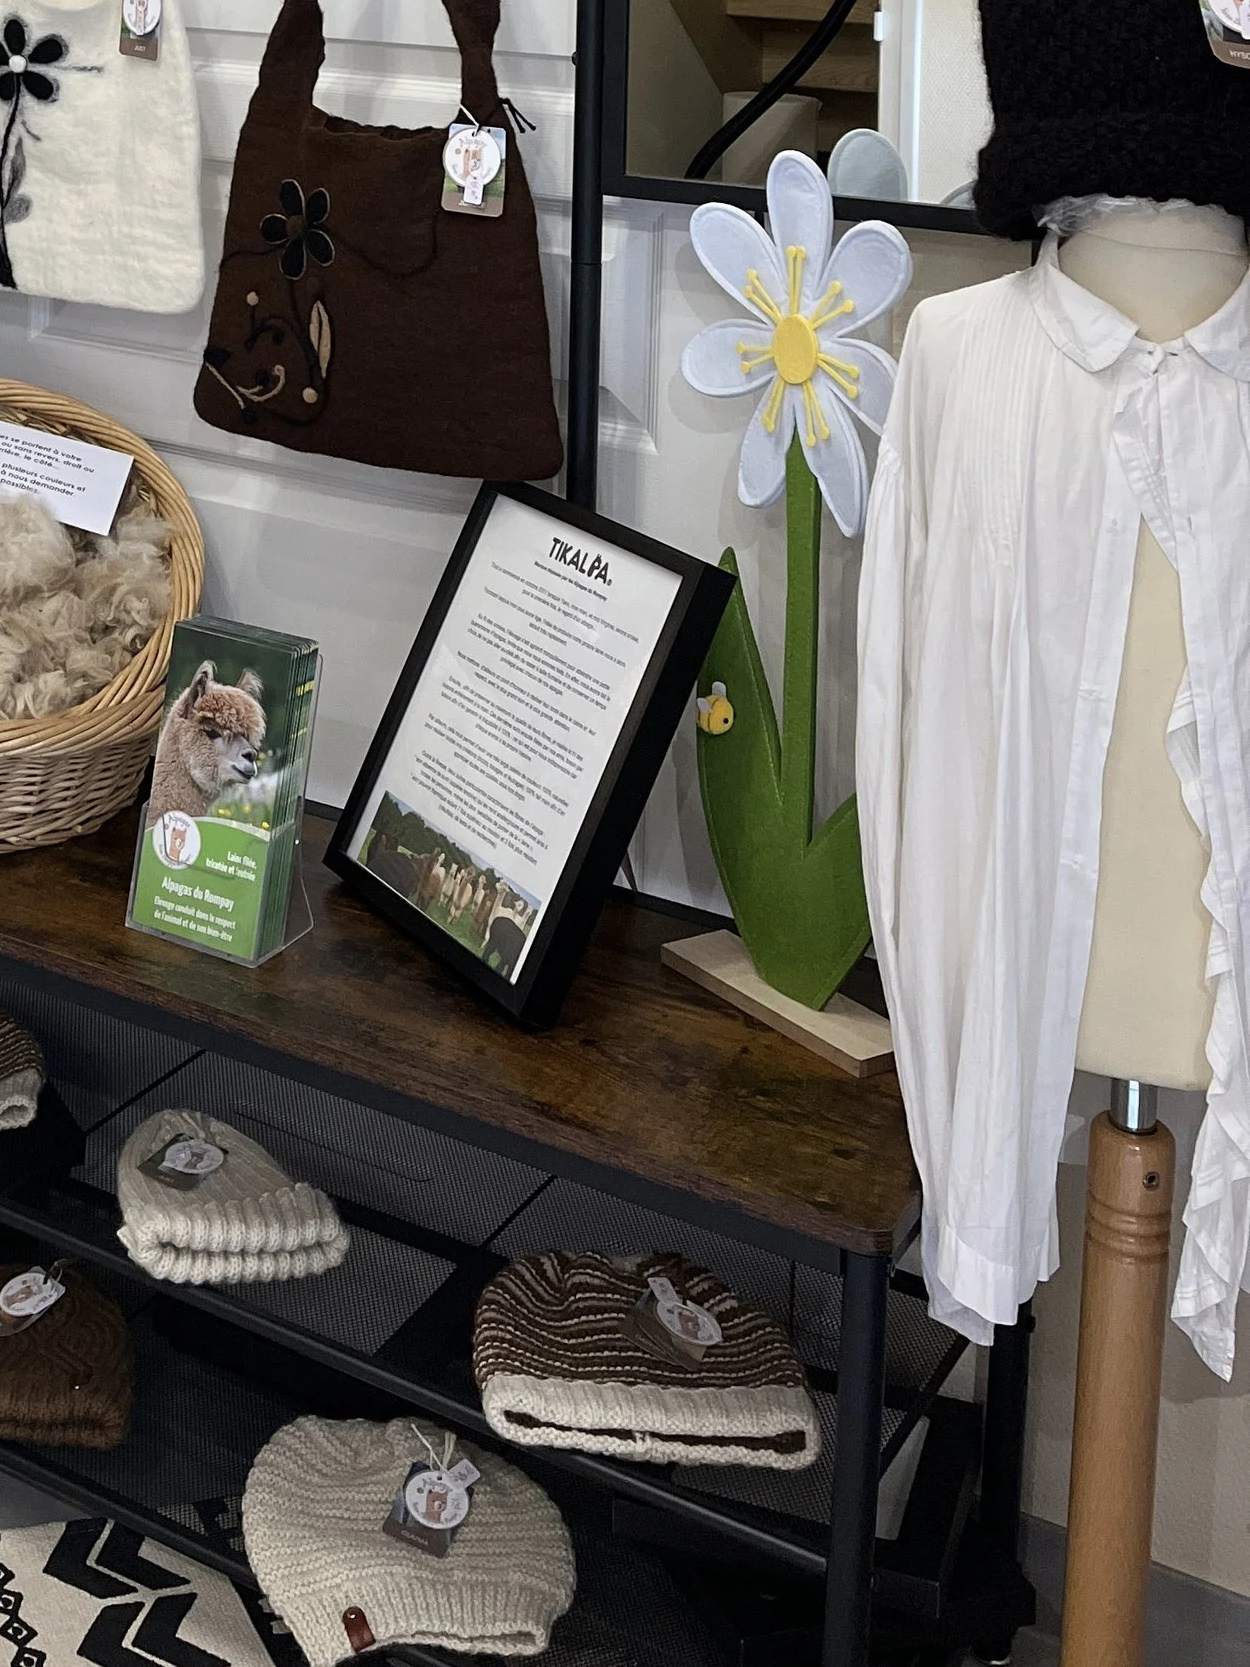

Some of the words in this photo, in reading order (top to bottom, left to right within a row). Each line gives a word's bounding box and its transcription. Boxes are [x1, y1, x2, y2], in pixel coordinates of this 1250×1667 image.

[14, 446, 33, 454] sans
[63, 460, 82, 469] droit
[21, 441, 52, 452] portent
[61, 452, 82, 462] votre
[2, 463, 38, 477] plusieurs
[39, 475, 75, 489] couleurs
[8, 472, 28, 482] nous
[229, 866, 235, 875] et
[162, 877, 192, 896] Alpagas
[194, 886, 203, 900] du
[205, 889, 234, 912] Rompay
[154, 910, 161, 919] de
[183, 920, 188, 928] et
[190, 921, 196, 930] de
